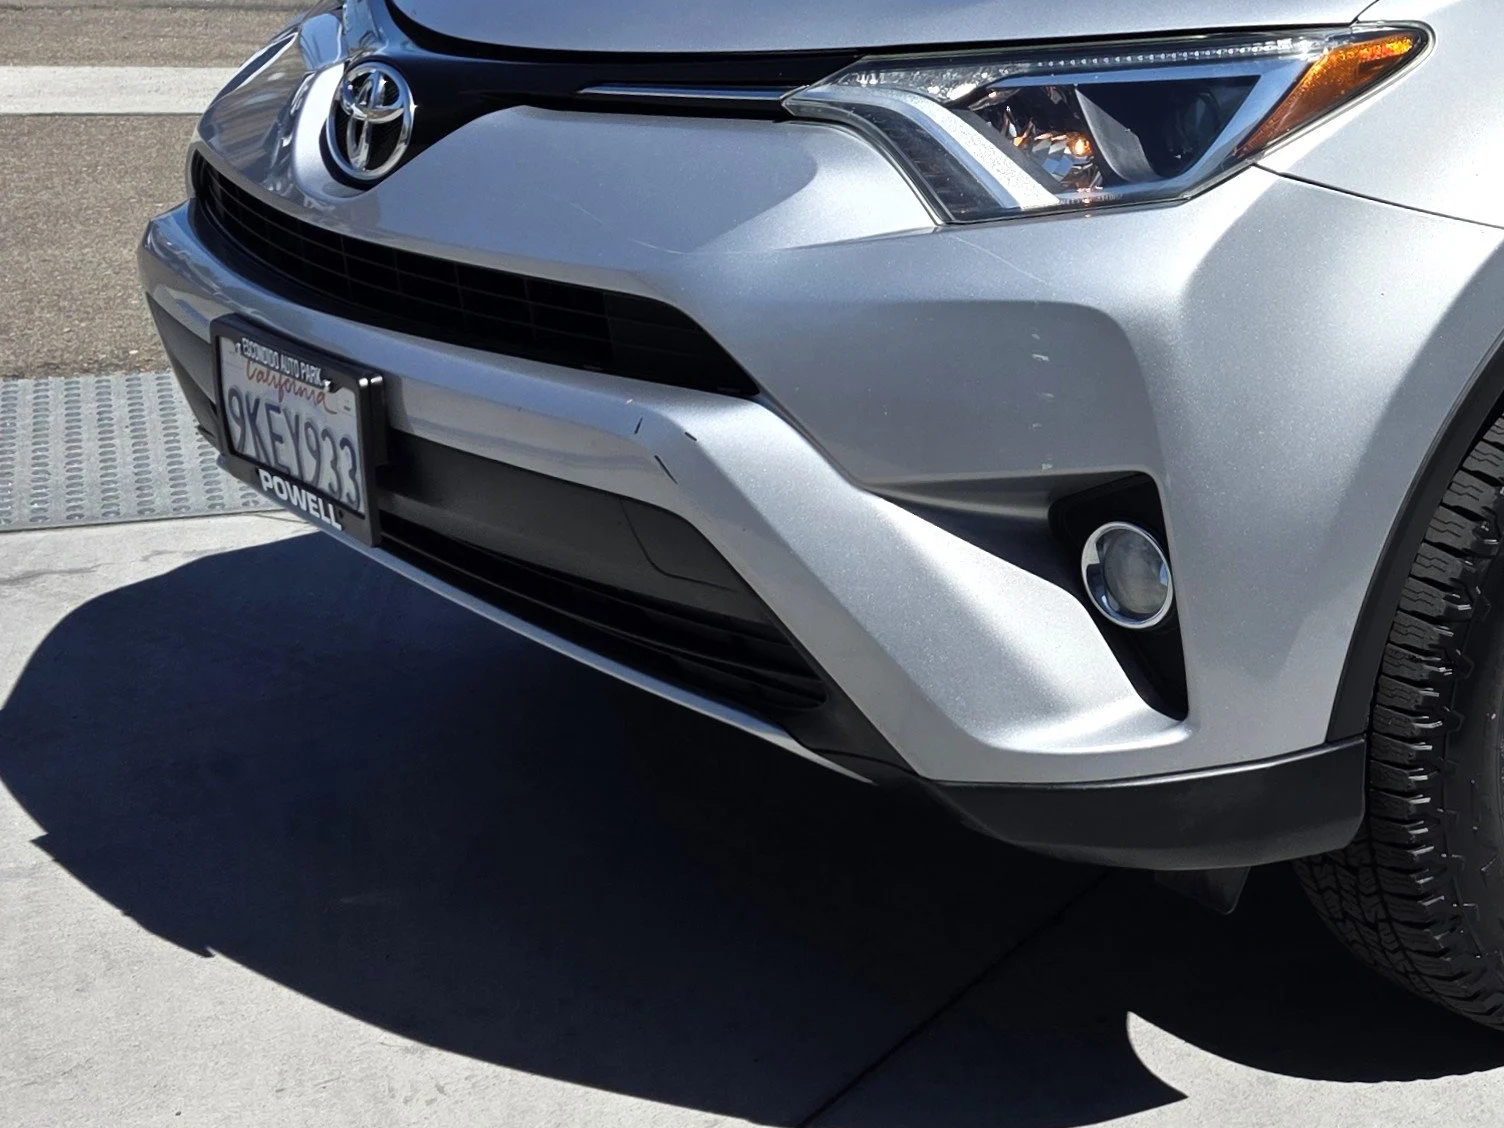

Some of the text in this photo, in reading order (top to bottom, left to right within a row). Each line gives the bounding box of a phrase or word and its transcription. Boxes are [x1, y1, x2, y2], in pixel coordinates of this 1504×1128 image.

[246, 358, 337, 414] California
[280, 353, 300, 379] AUTO
[300, 361, 322, 386] PARK
[227, 385, 361, 512] 9KEY933
[258, 468, 343, 531] POWELL
